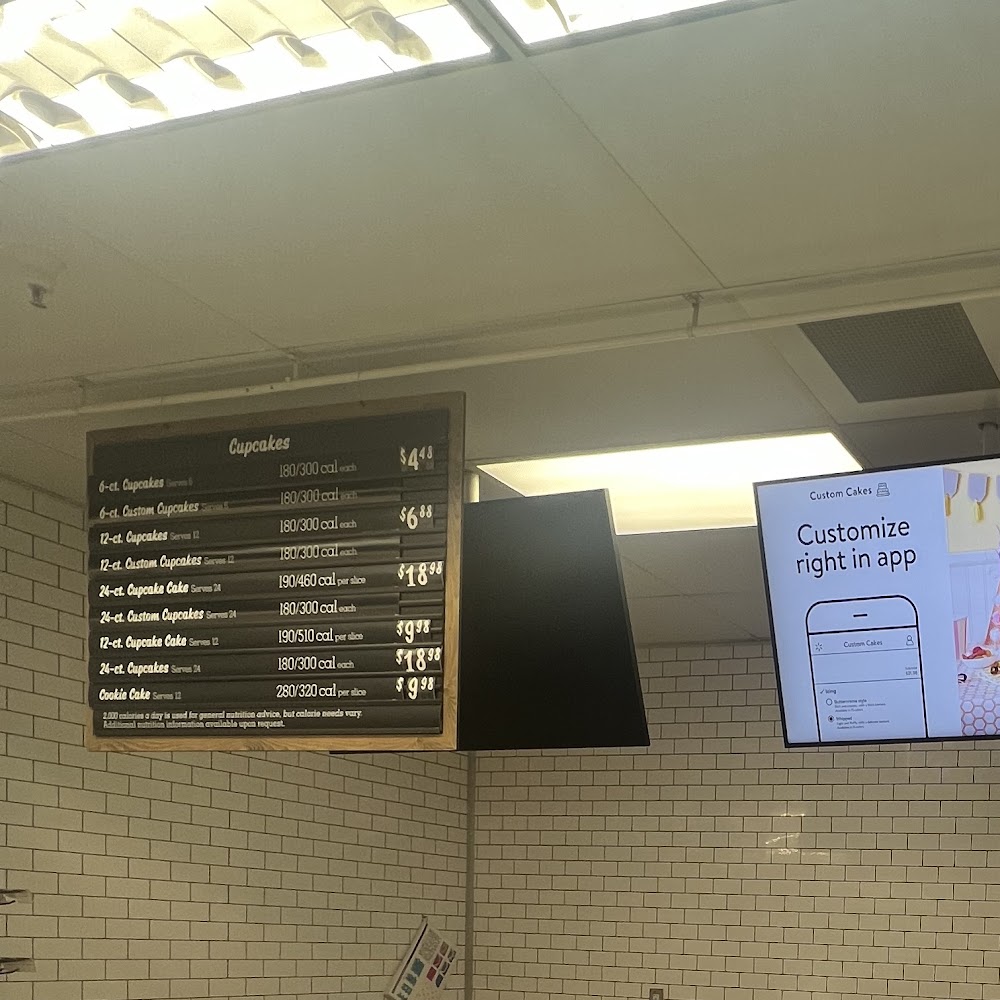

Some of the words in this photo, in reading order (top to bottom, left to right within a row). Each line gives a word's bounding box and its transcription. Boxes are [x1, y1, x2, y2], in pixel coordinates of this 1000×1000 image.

[229, 435, 291, 458] Cupcakes
[99, 480, 120, 493] 6-ct.
[122, 476, 165, 493] Cupcakes
[810, 490, 844, 501] Custom
[846, 486, 872, 497] Cakes
[100, 506, 121, 519] 6-ct.
[122, 504, 155, 517] Custom
[157, 501, 200, 517] Cupcakes
[100, 532, 123, 545] 12-ct.
[126, 529, 168, 545] Cupcakes
[797, 516, 911, 546] Customize
[100, 558, 122, 571] 12-ct.
[125, 557, 158, 570] Custom
[160, 554, 202, 570] Cupcakes
[796, 550, 847, 578] right
[852, 548, 871, 569] in
[877, 549, 916, 573] app
[278, 573, 317, 589] 190/460
[318, 572, 336, 586] cal
[99, 584, 125, 597] 24-ct.
[127, 583, 164, 598] Cupcake
[166, 581, 190, 594] Cake
[100, 611, 125, 624] 24-ct.
[127, 609, 160, 622] Custom
[162, 607, 204, 624] Cupcakes
[280, 600, 319, 616] 180/300
[319, 599, 338, 613] cal
[100, 637, 123, 649] 12-ct.
[126, 635, 162, 651] Cupcake
[164, 633, 187, 647] Cake
[278, 629, 315, 643] 190/510
[315, 628, 334, 642] cal
[843, 641, 865, 649] Custom
[866, 639, 883, 647] Cakes
[99, 662, 125, 674] 24-ct.
[127, 661, 169, 677] Cupcakes
[278, 657, 317, 671] 180/300
[318, 656, 336, 669] cal
[99, 688, 127, 700] Cookie
[129, 687, 151, 700] Cake
[276, 683, 318, 698] 280/320
[318, 682, 337, 696] cal
